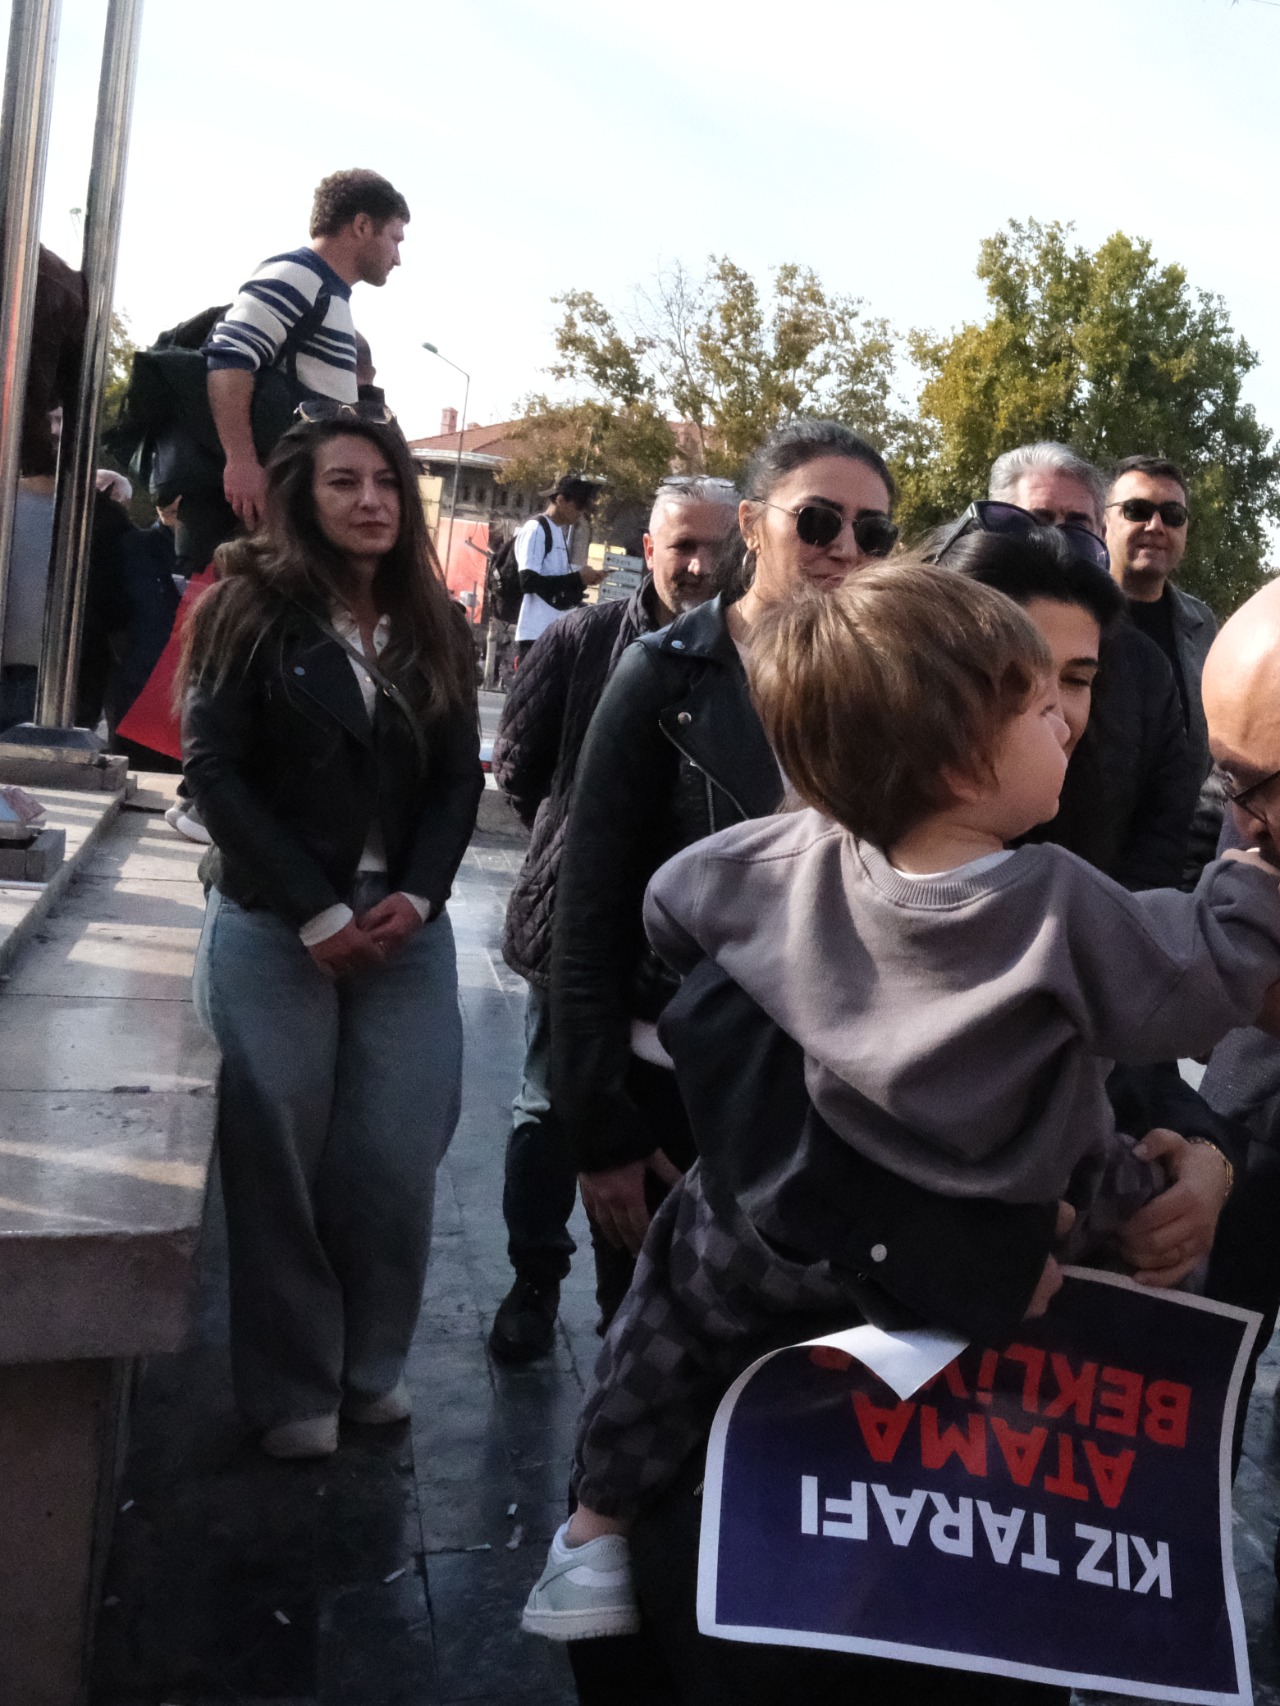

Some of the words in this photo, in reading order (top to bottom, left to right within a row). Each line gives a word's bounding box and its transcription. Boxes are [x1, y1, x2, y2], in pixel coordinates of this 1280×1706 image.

[852, 1389, 1136, 1509] ATAMA
[801, 1475, 1060, 1576] TARAFI
[1075, 1522, 1174, 1598] KIZ
